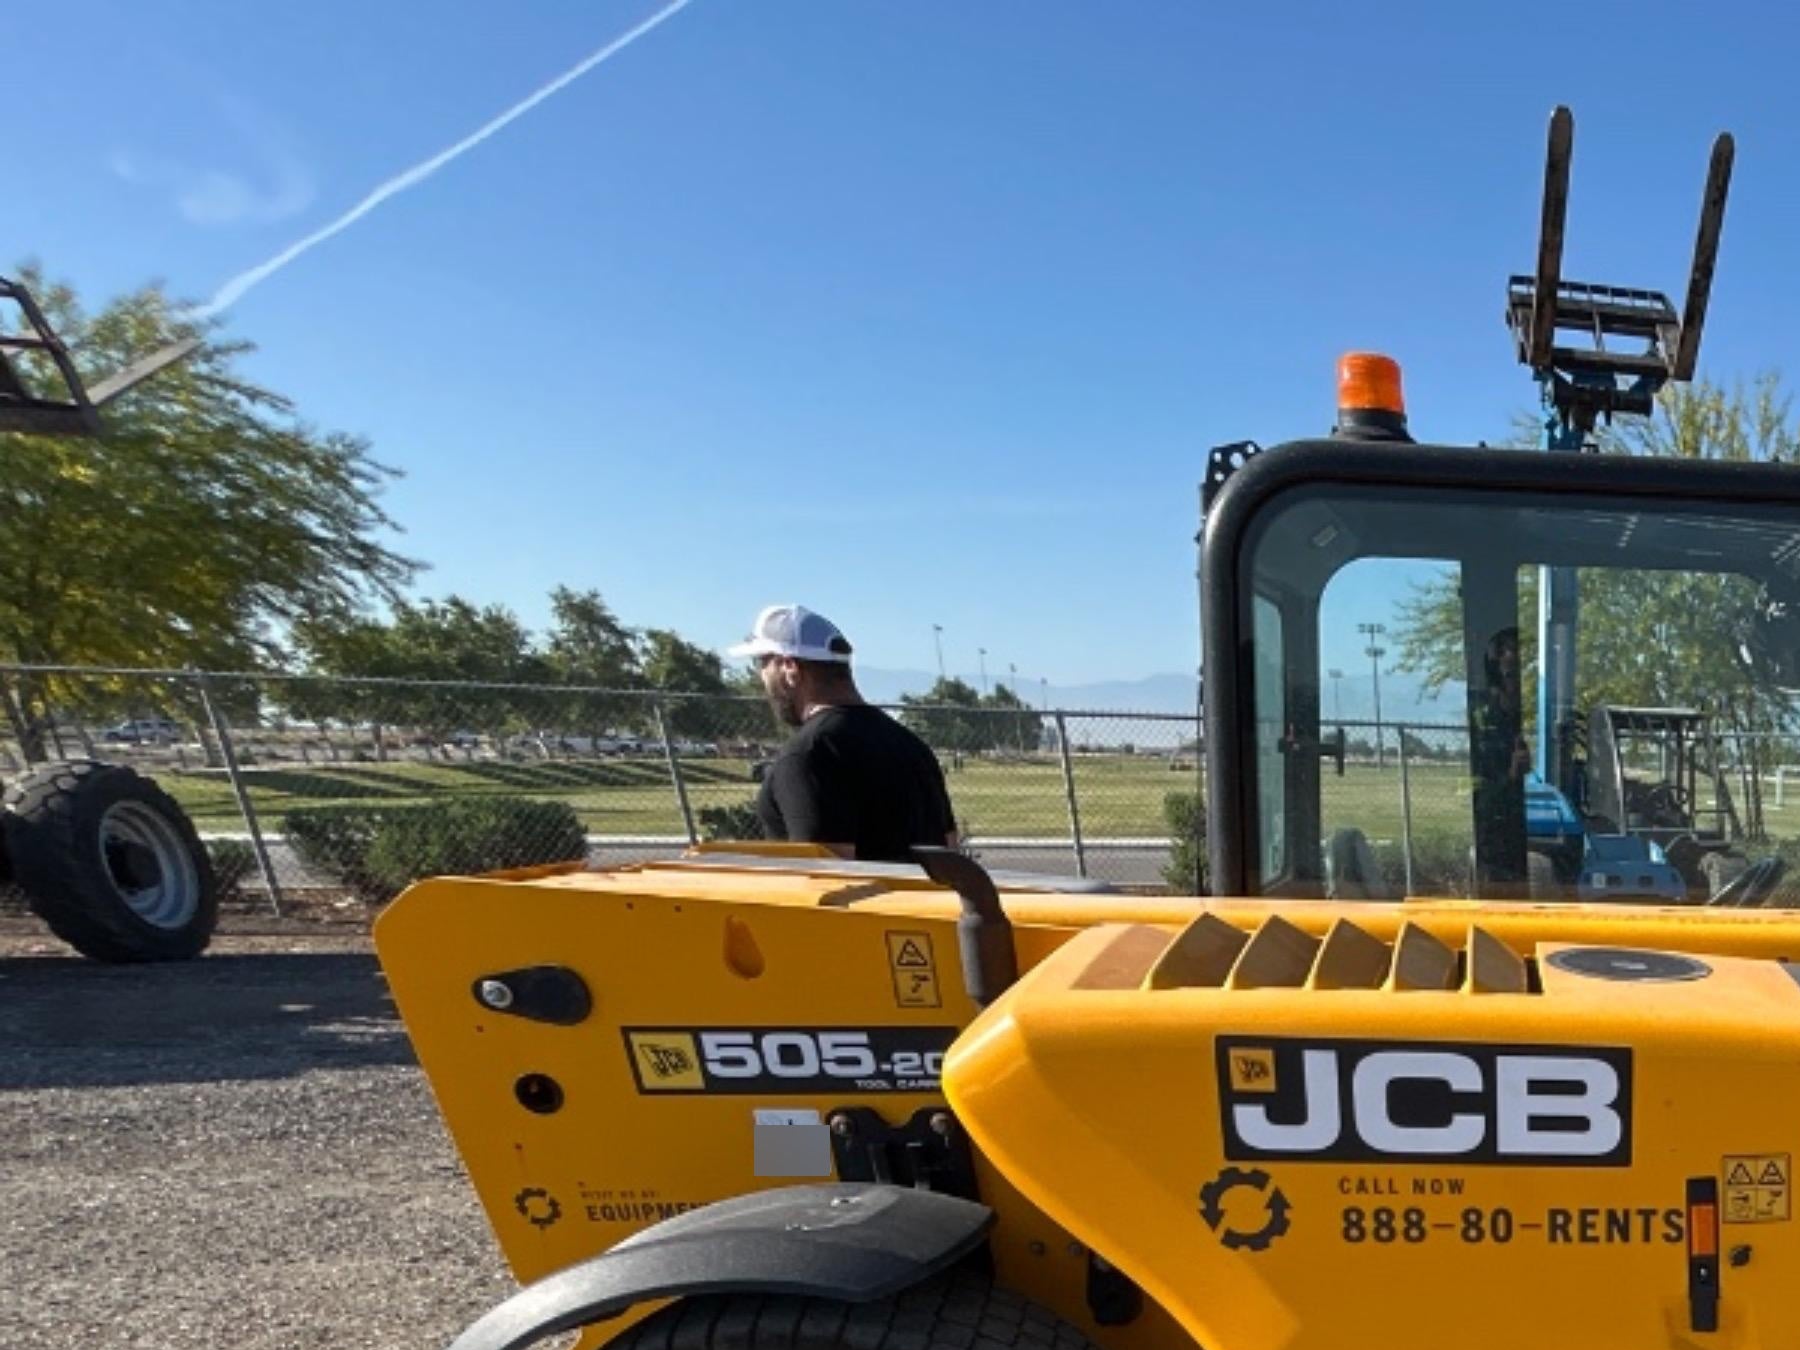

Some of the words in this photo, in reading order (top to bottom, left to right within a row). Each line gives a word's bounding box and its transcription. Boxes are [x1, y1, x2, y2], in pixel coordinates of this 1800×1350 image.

[1231, 1048, 1622, 1156] JCB
[1338, 1176, 1399, 1196] CALL
[1412, 1178, 1466, 1196] NOW
[1342, 1207, 1685, 1245] 888-80-RENTS
